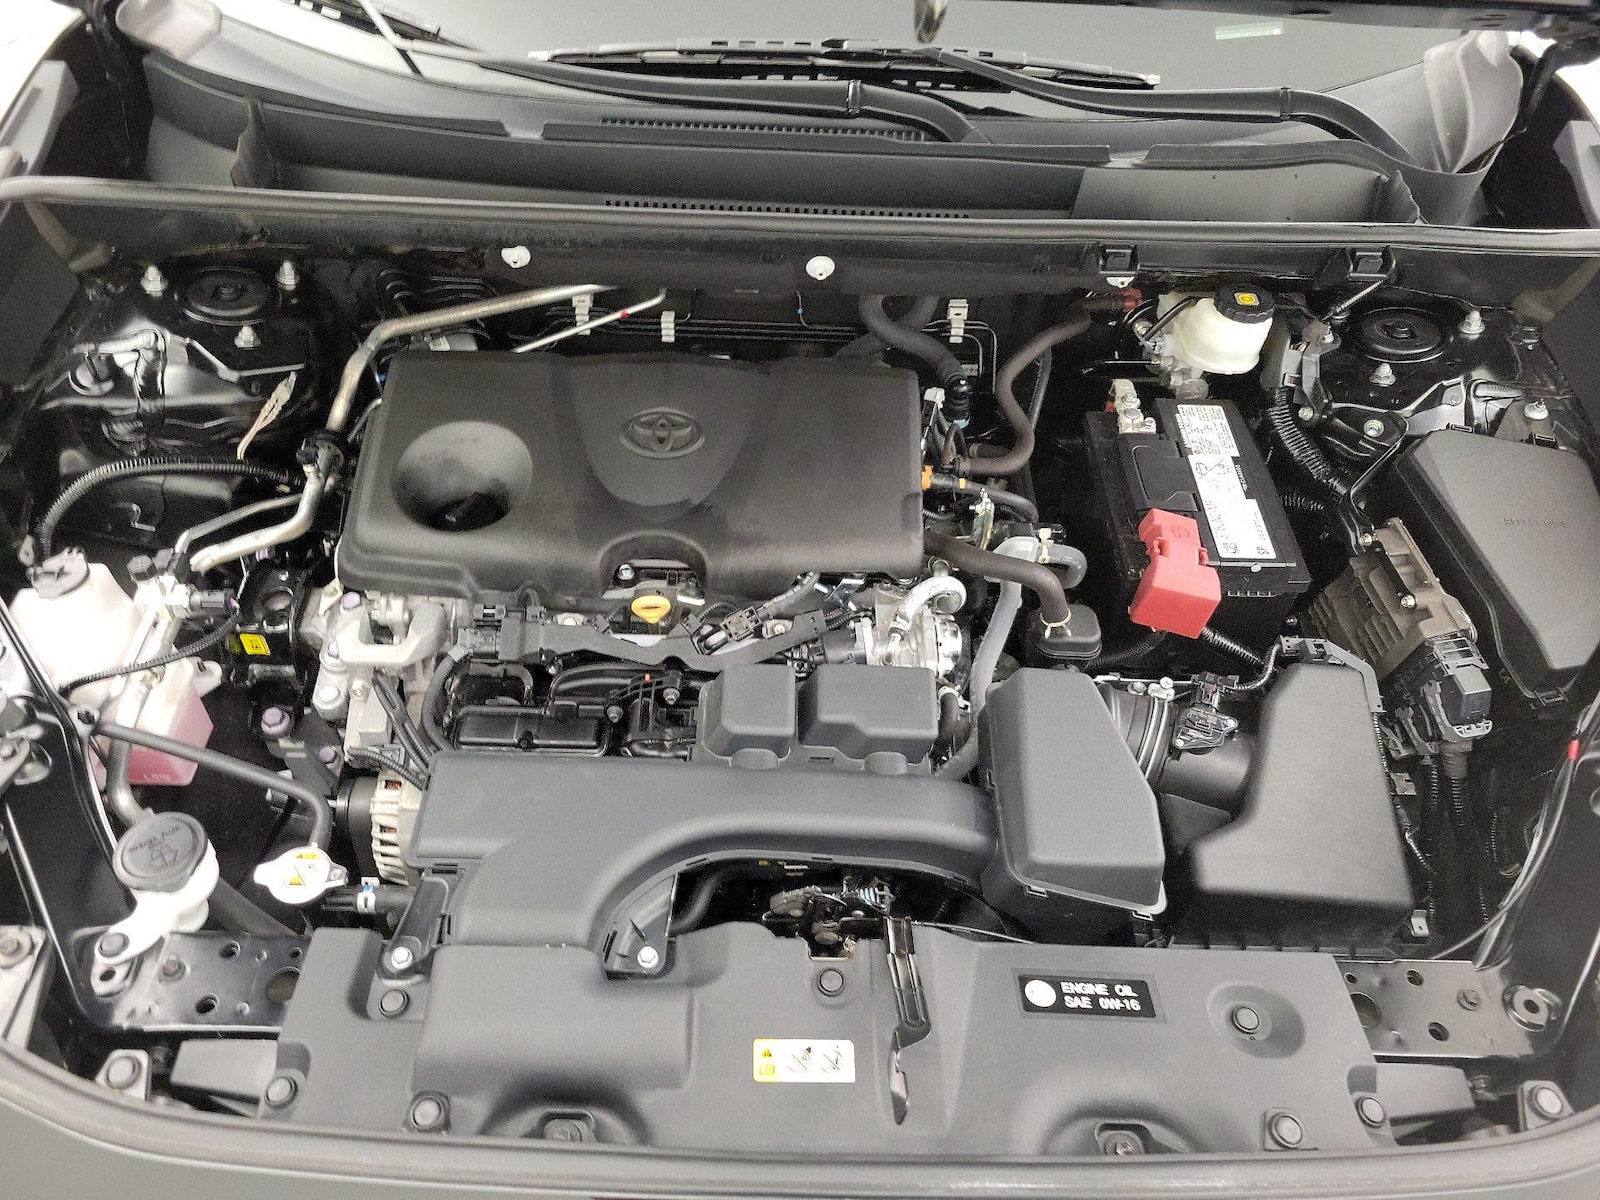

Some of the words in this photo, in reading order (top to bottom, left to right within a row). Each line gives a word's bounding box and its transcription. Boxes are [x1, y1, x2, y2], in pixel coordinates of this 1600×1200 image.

[1256, 546, 1270, 555] SP
[1060, 982, 1109, 996] ENGINE
[1114, 984, 1138, 997] OIL
[1063, 995, 1093, 1009] SAE
[1099, 997, 1141, 1011] 0W-16
